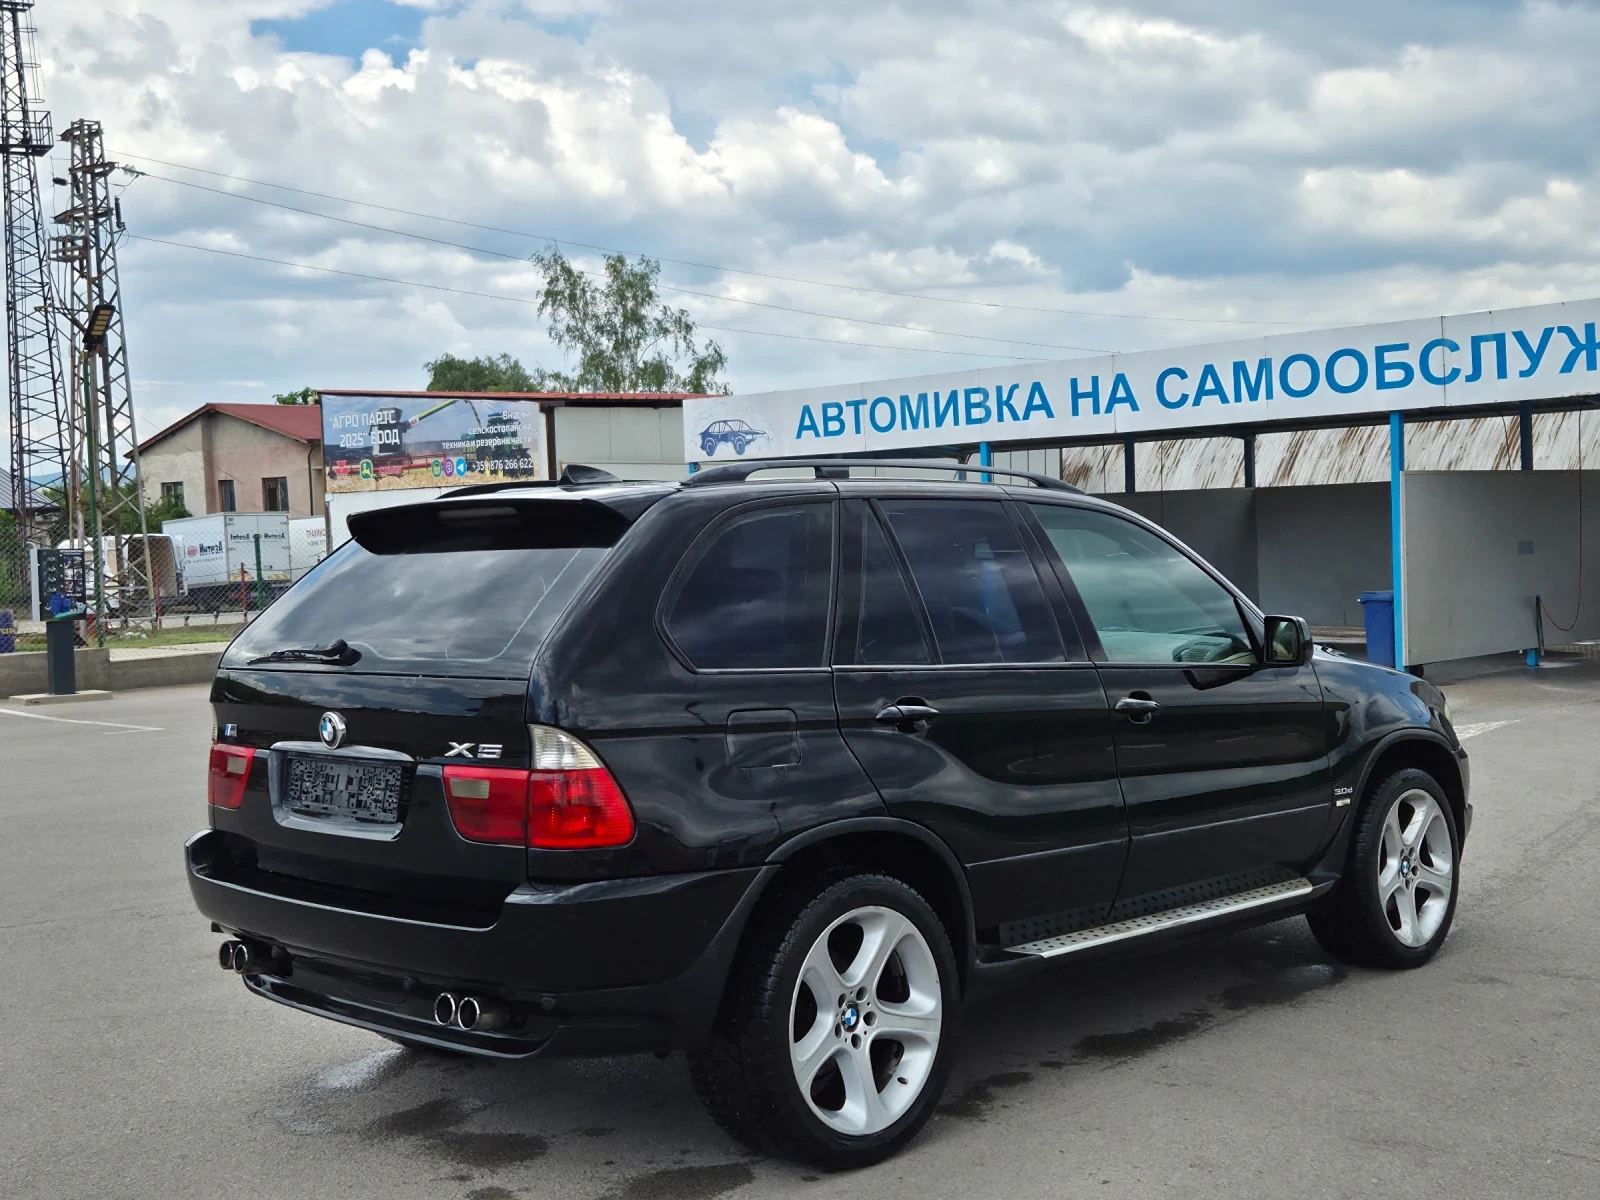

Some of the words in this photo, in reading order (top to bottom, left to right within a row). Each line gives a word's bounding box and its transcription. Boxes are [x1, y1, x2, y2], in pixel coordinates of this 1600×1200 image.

[795, 380, 1054, 440] АВТОМИВКА
[1070, 372, 1140, 417] НА
[1155, 322, 1600, 410] САМООБСЛУЖ
[361, 409, 397, 426] ПАРТС
[502, 410, 521, 420] Внос
[521, 410, 531, 418] на
[468, 423, 532, 435] селскостопанска
[370, 428, 400, 446] ЕООД
[442, 440, 470, 450] техника
[476, 437, 510, 448] резервни
[510, 436, 533, 445] части
[490, 459, 504, 470] 876
[504, 459, 518, 470] 266
[520, 458, 533, 469] 622
[444, 741, 503, 759] X5
